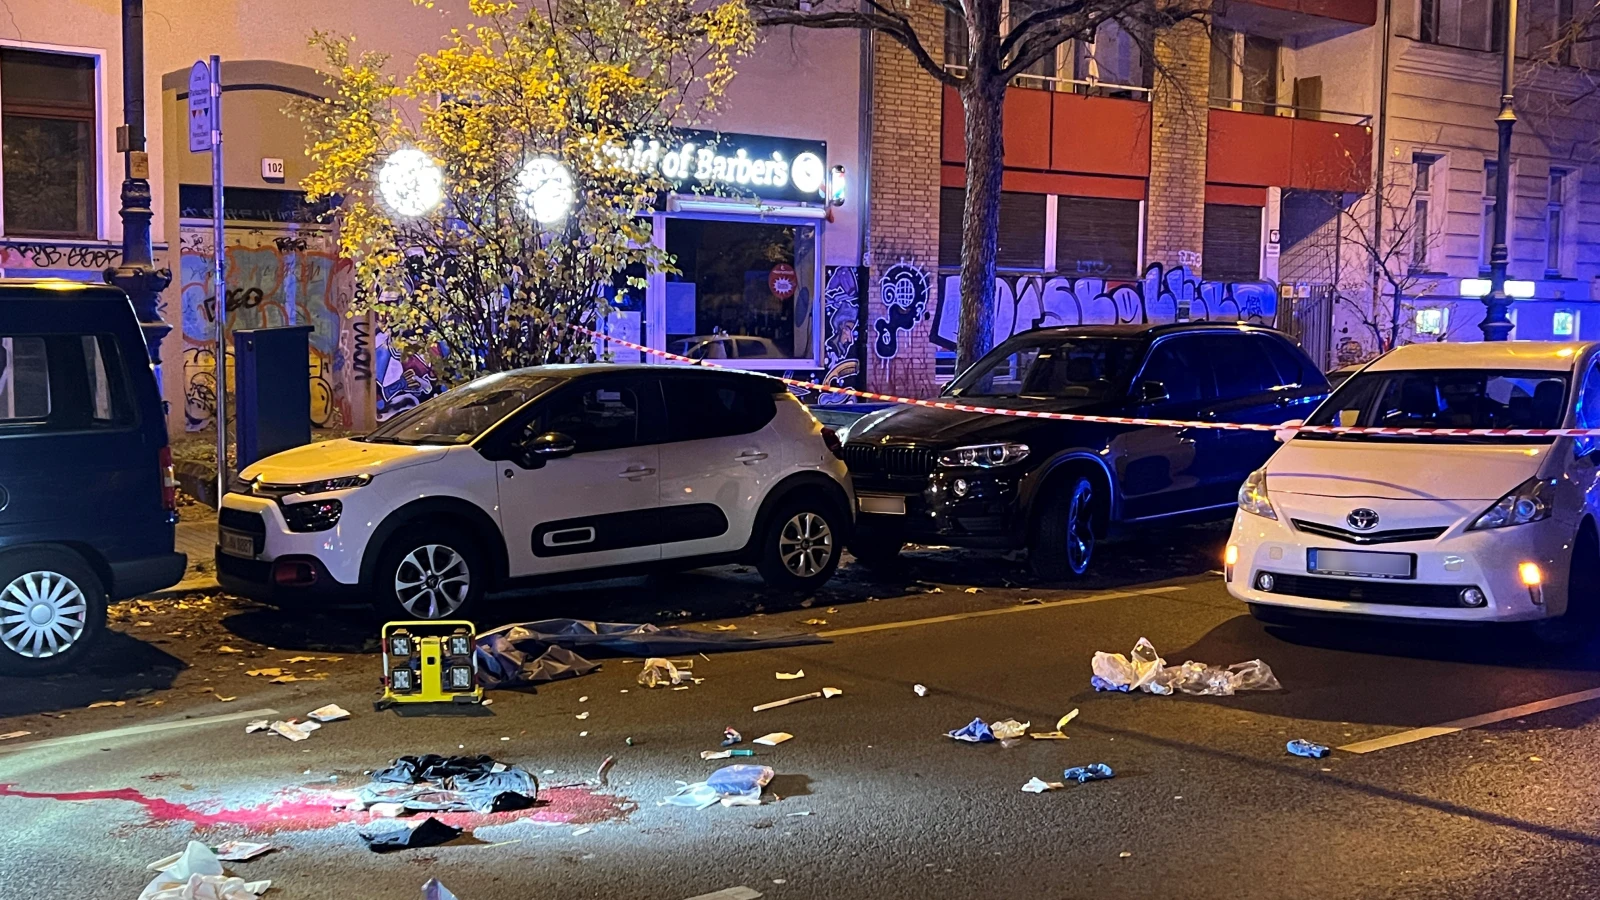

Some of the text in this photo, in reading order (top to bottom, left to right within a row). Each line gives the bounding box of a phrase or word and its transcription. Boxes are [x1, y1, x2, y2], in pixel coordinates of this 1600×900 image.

[267, 162, 283, 173] 102
[661, 143, 694, 179] of
[696, 148, 789, 188] Barber's
